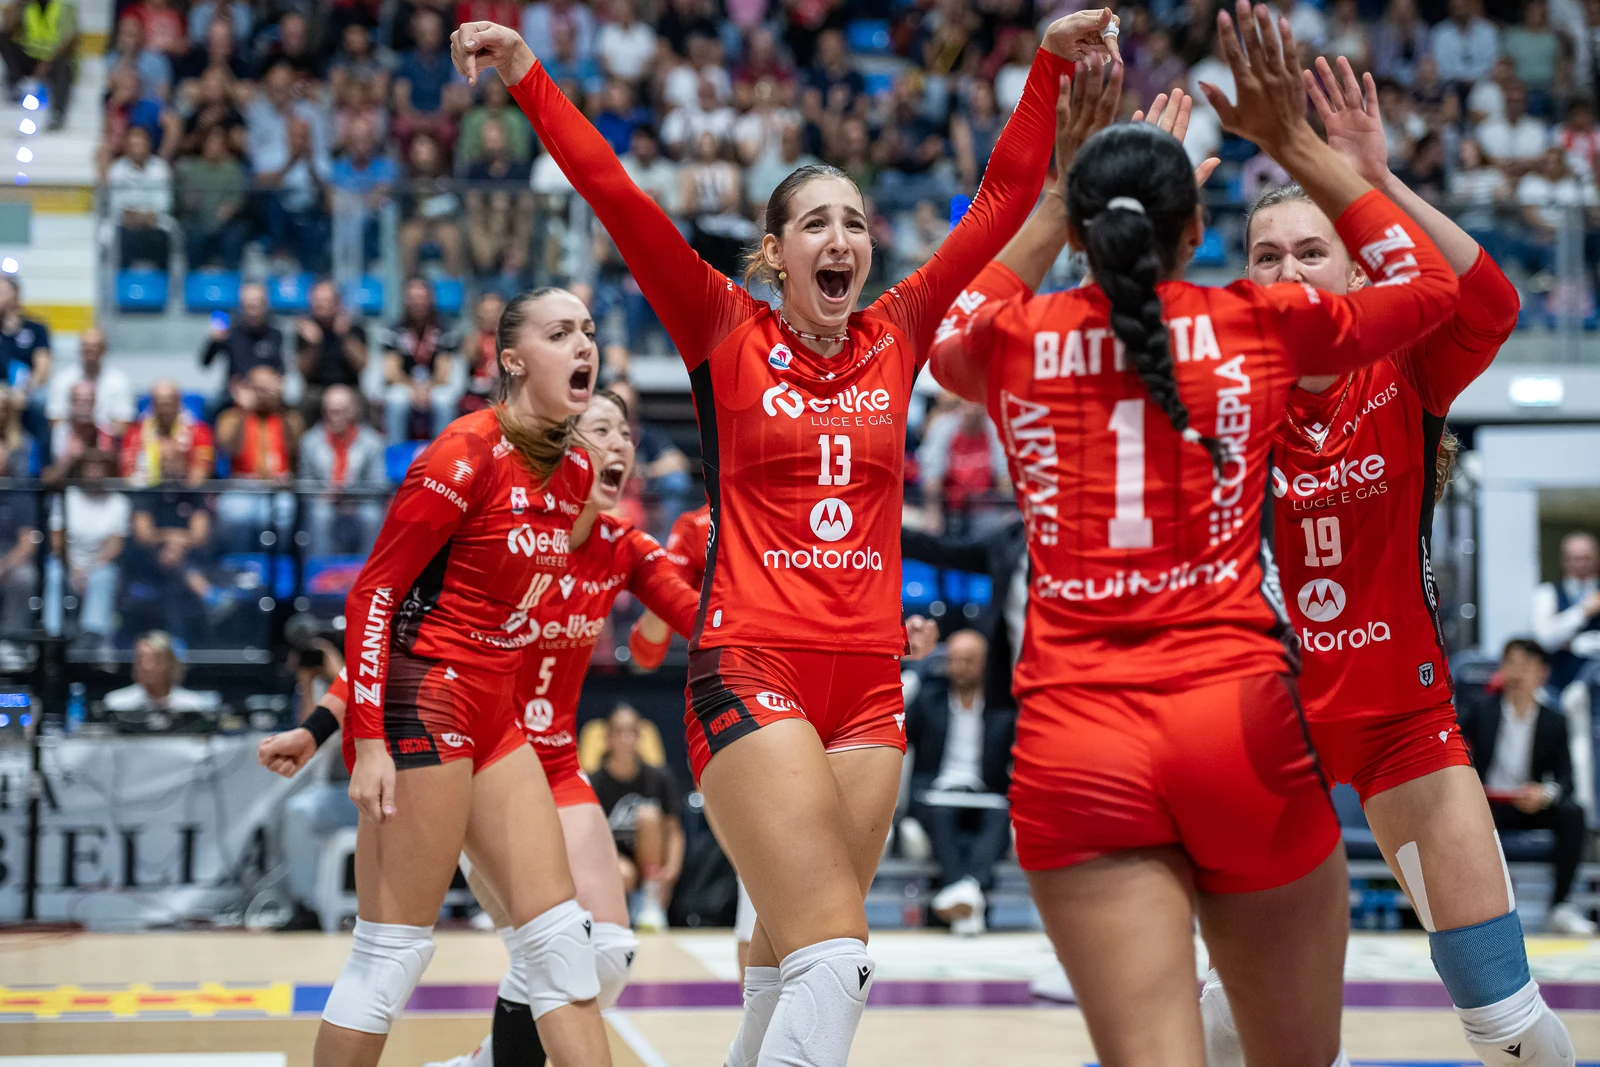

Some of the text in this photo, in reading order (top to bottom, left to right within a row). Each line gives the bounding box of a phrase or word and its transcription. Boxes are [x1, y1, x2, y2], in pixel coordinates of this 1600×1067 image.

[1034, 314, 1222, 380] BATTTA
[811, 413, 893, 428] LUCE E GAS
[817, 434, 852, 486] 13
[1108, 399, 1154, 549] 1
[1293, 481, 1388, 511] LUCE E GAS
[763, 545, 883, 571] motorola
[1301, 516, 1343, 567] 19
[515, 572, 553, 610] 18
[359, 587, 393, 678] ZANUTTA
[1294, 621, 1391, 652] torola
[535, 656, 557, 695] 5
[0, 824, 268, 891] ELLA
